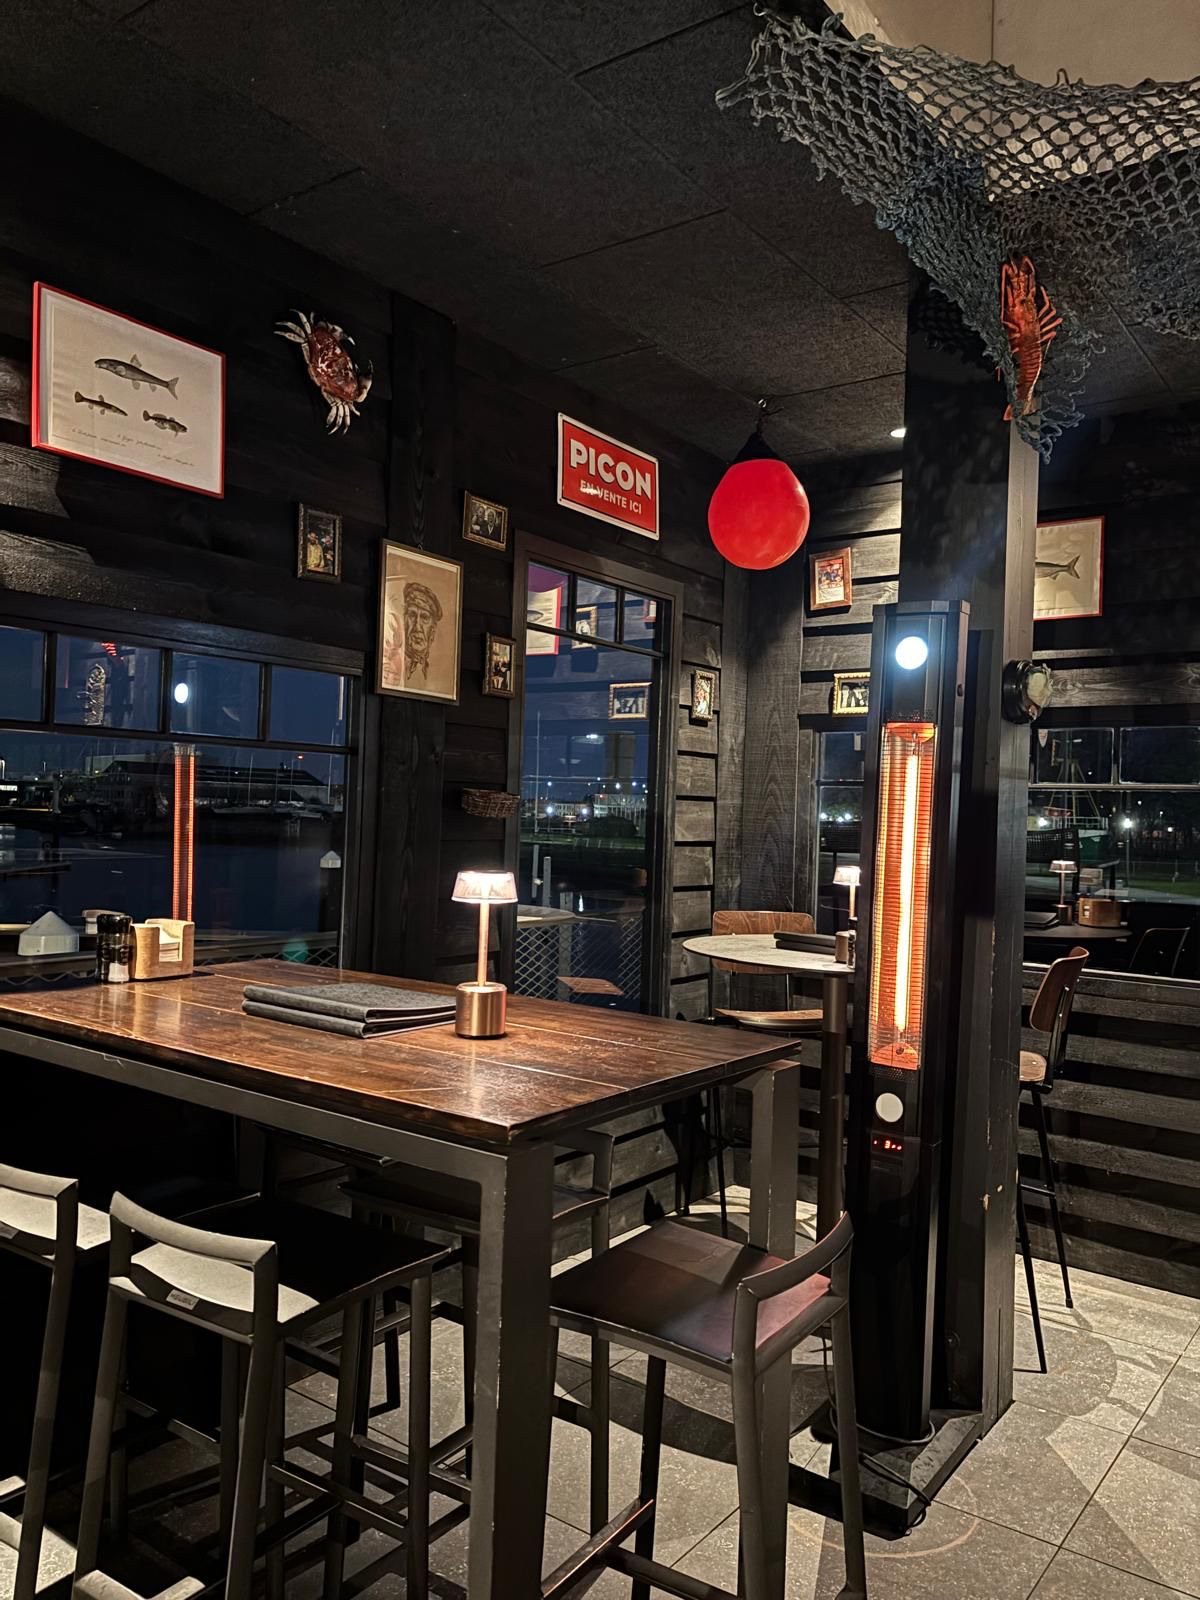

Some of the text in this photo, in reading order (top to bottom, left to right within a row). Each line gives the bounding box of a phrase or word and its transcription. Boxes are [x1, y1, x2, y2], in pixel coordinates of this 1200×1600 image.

[570, 438, 652, 500] PICON
[596, 485, 628, 509] VENTE
[629, 499, 642, 515] ICI
